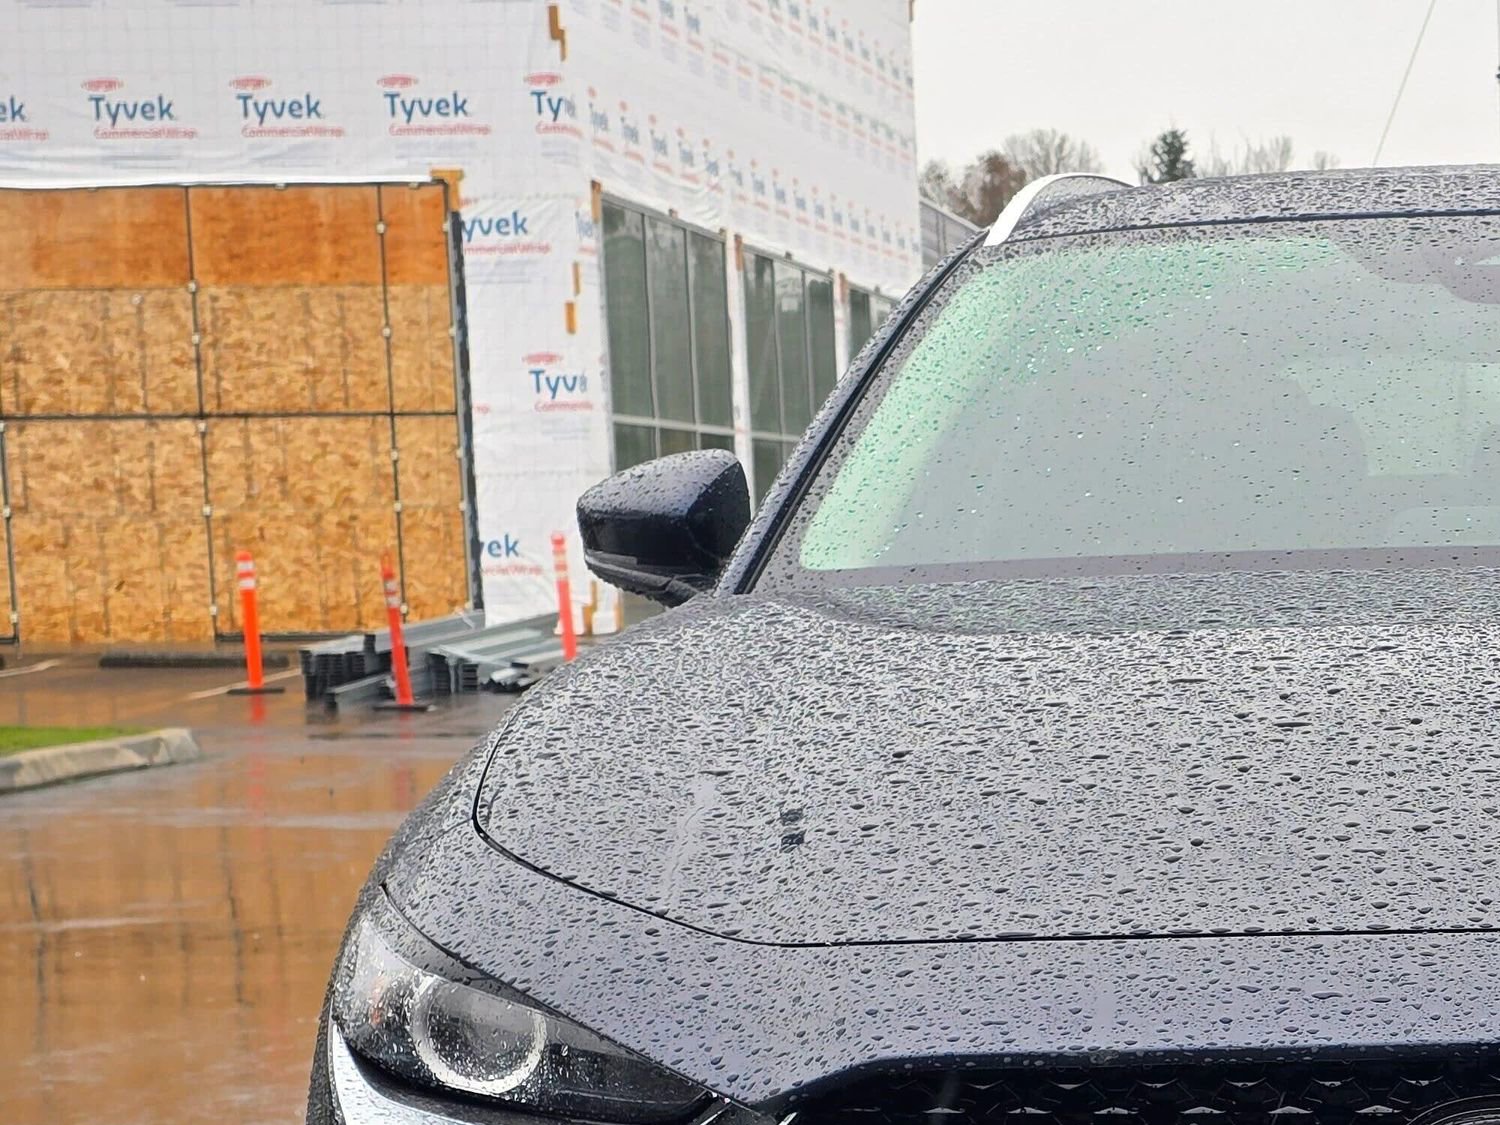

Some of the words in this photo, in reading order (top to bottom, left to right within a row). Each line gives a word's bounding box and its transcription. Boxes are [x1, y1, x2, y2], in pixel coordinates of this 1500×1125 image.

[88, 94, 176, 127] Tyvek
[236, 92, 323, 126] Tyvek
[383, 90, 469, 124] Tyvek
